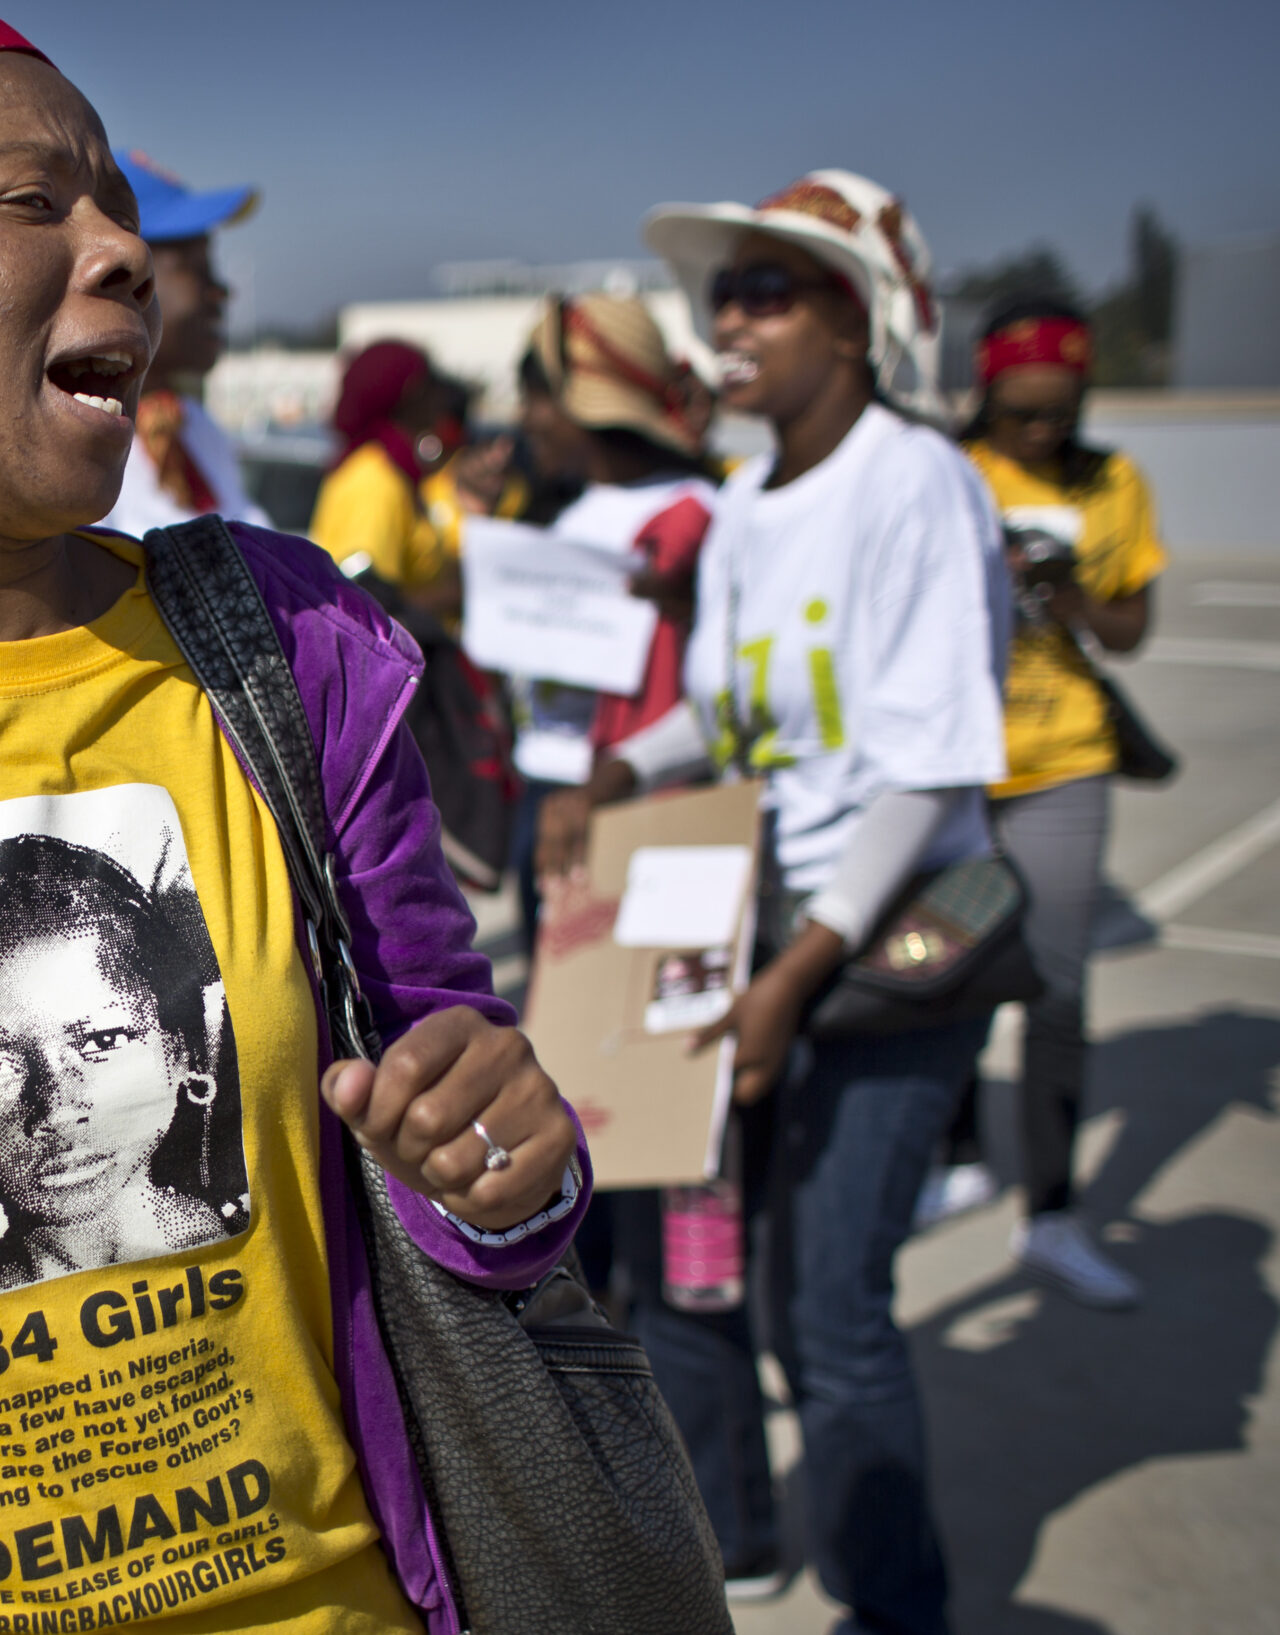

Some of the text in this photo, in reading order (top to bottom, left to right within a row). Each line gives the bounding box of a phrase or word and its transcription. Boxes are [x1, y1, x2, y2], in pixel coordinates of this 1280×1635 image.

[80, 1266, 244, 1348] Girls
[19, 1406, 65, 1432] few
[73, 1392, 136, 1417] have
[140, 1347, 235, 1399] escaped,
[99, 1369, 122, 1389] in
[128, 1337, 215, 1379] Nigeria,
[1, 1464, 44, 1479] are
[52, 1448, 92, 1473] the
[99, 1421, 191, 1458] Foreign
[193, 1388, 254, 1428] Govt's
[35, 1428, 75, 1453] are
[83, 1416, 127, 1438] not
[134, 1401, 169, 1434] yet
[170, 1371, 235, 1413] found.
[37, 1482, 64, 1498] to
[71, 1459, 158, 1493] rescue
[166, 1418, 241, 1468] others?
[21, 1566, 123, 1604] RELEASE
[127, 1554, 155, 1578] OF
[161, 1537, 210, 1565] OUR
[216, 1512, 280, 1546] GIRLS
